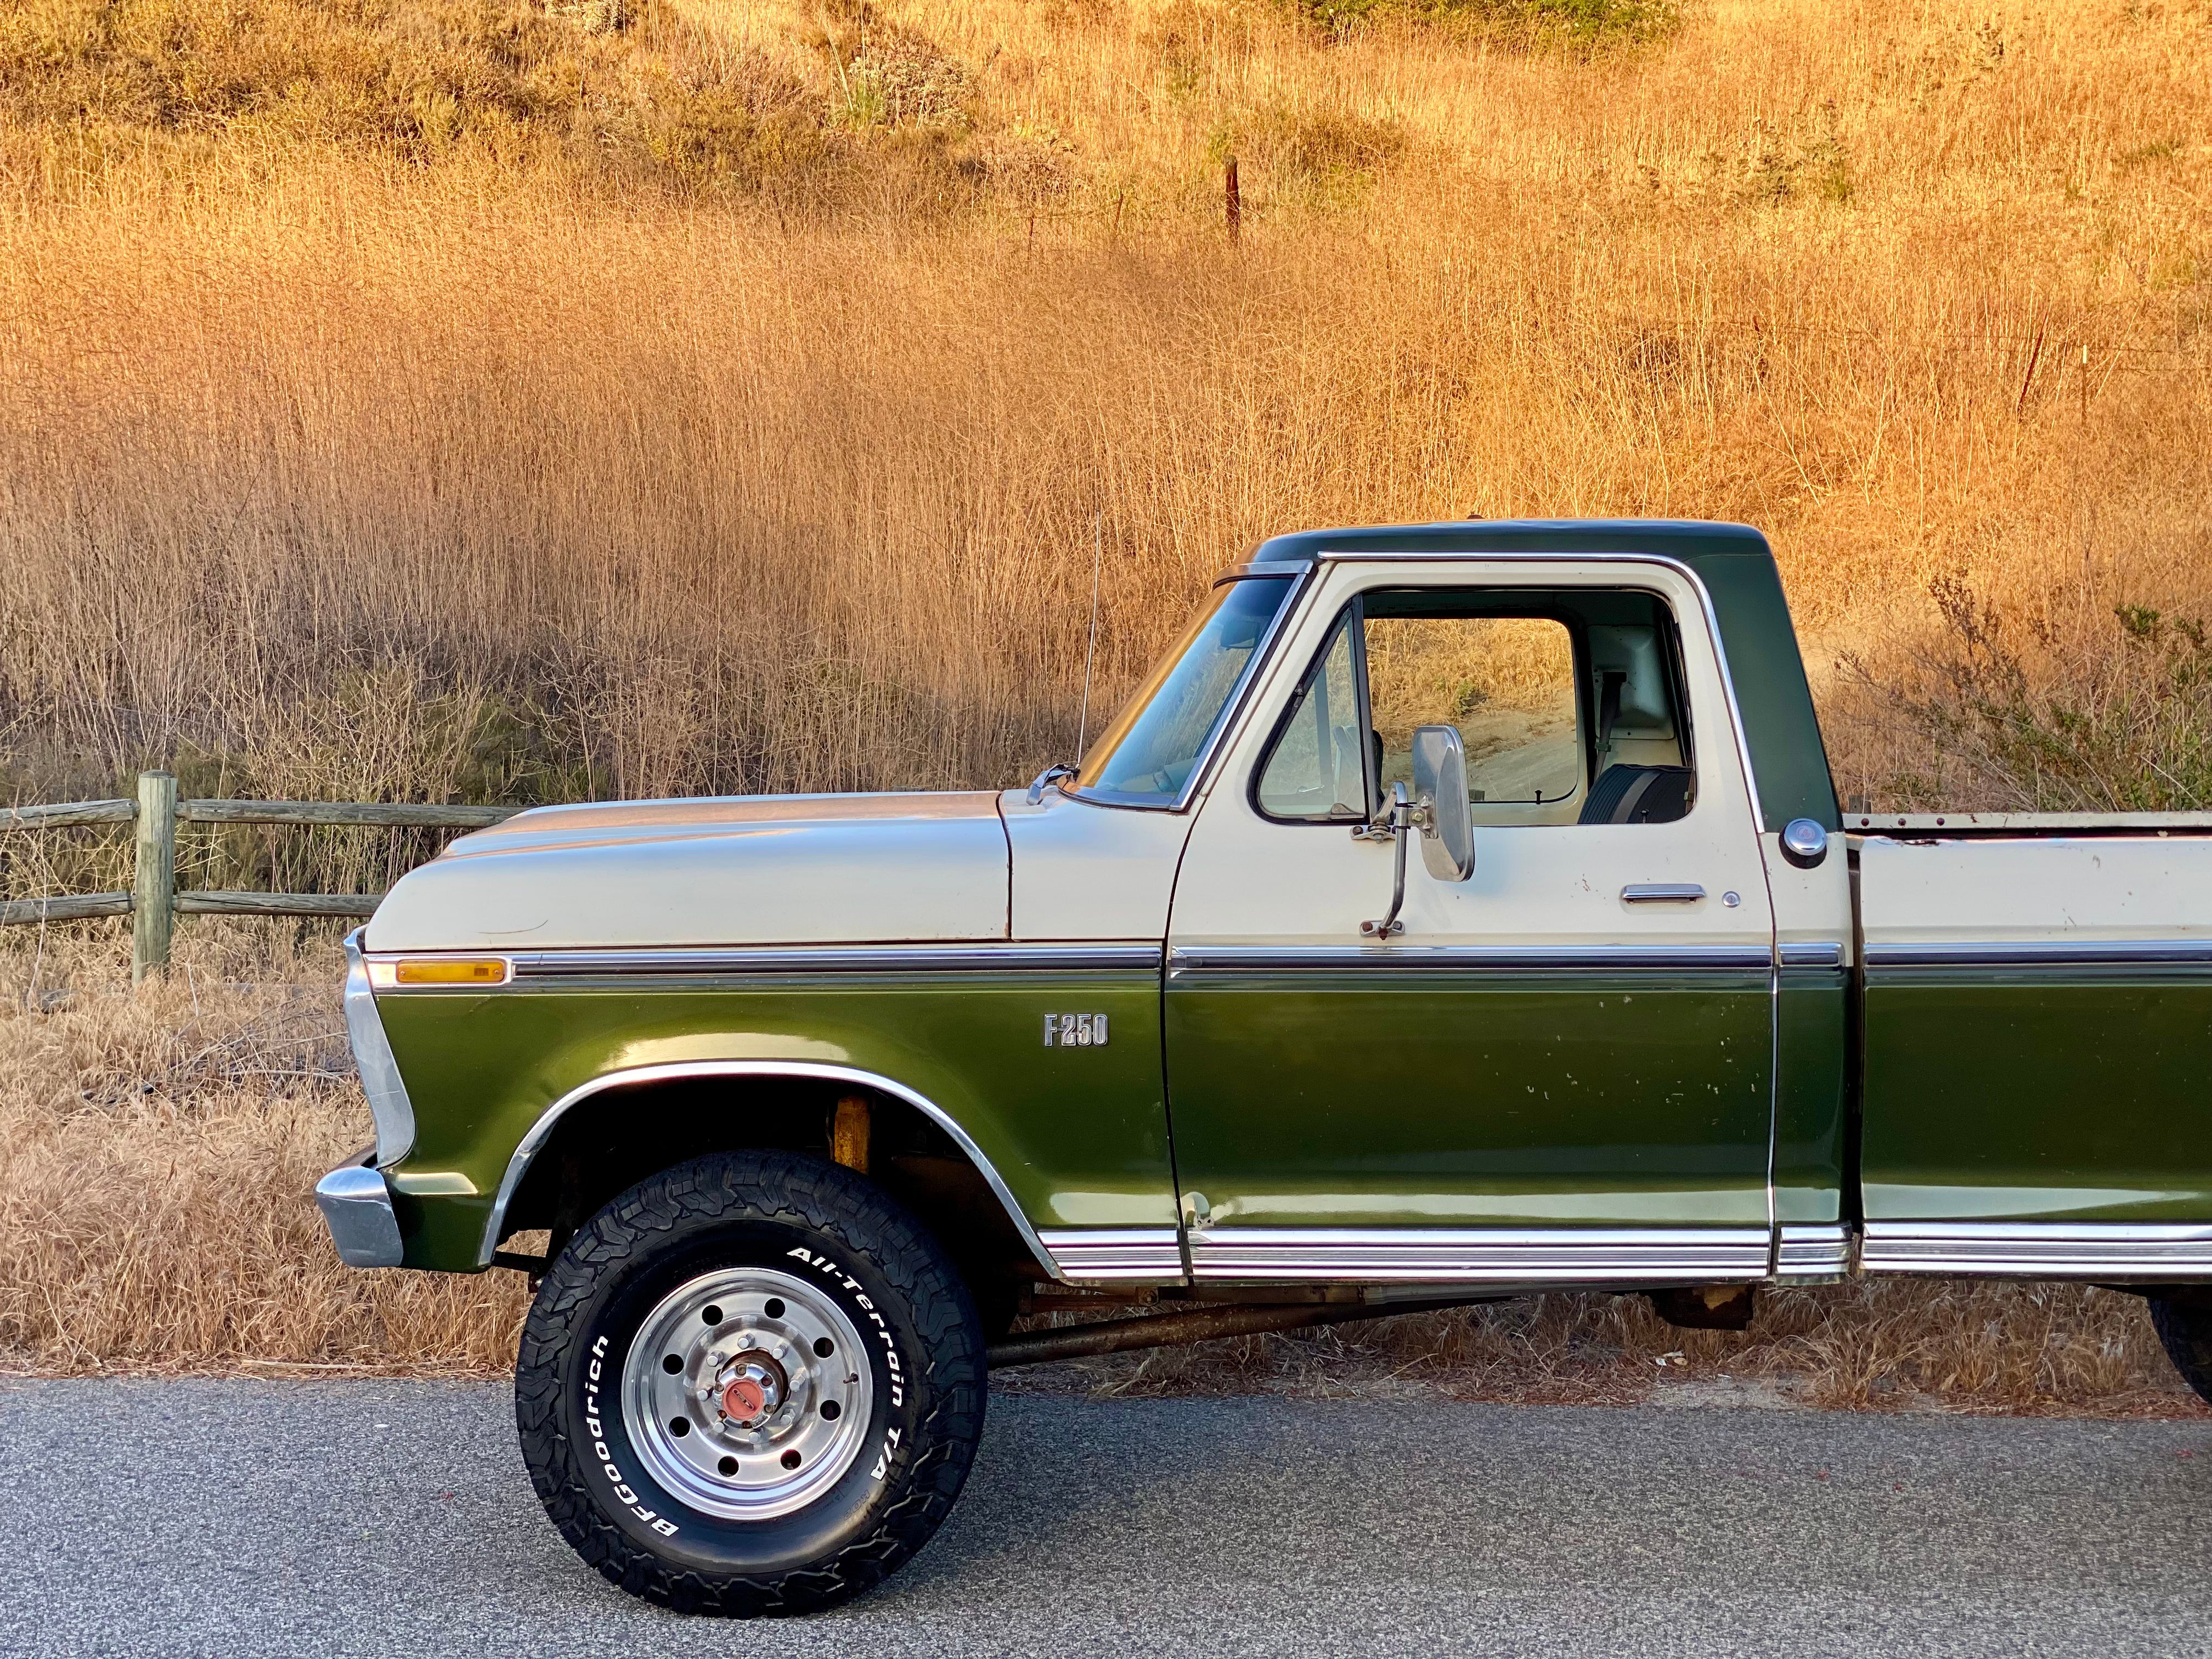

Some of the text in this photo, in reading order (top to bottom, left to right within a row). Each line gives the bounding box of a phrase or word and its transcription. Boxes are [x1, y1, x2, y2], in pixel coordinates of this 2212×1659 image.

[585, 1336, 679, 1537] BFGoodrich
[787, 1246, 904, 1480] All-Terrain T/A
